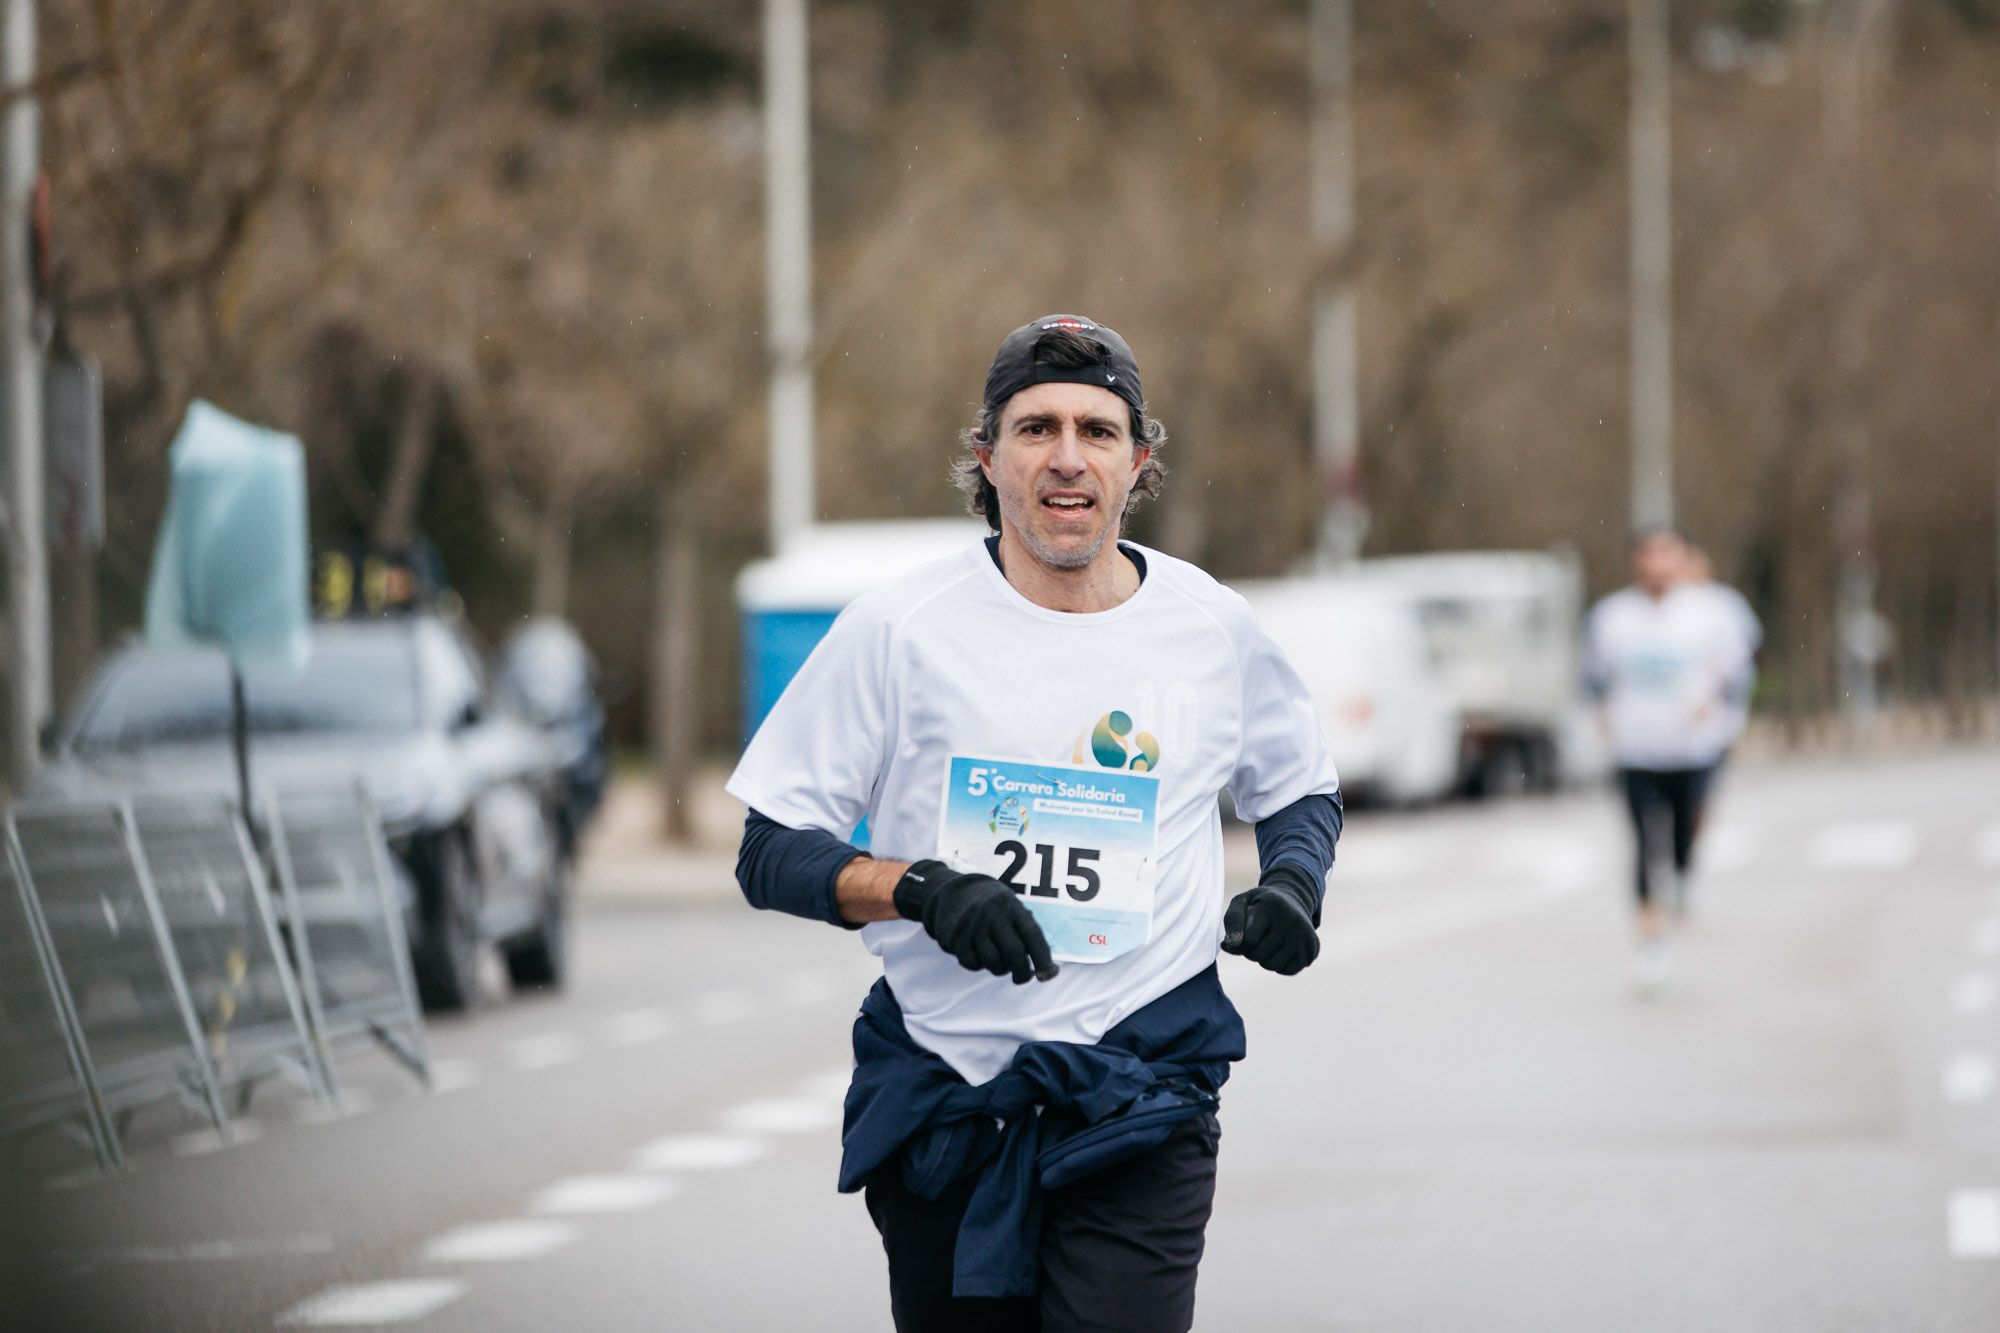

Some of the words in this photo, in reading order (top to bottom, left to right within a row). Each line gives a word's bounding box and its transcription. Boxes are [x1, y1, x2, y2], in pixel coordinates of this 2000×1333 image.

[991, 775, 1054, 796] Carrera
[1057, 782, 1126, 803] Solidaria
[994, 839, 1101, 902] 215
[1088, 933, 1108, 946] CSL
